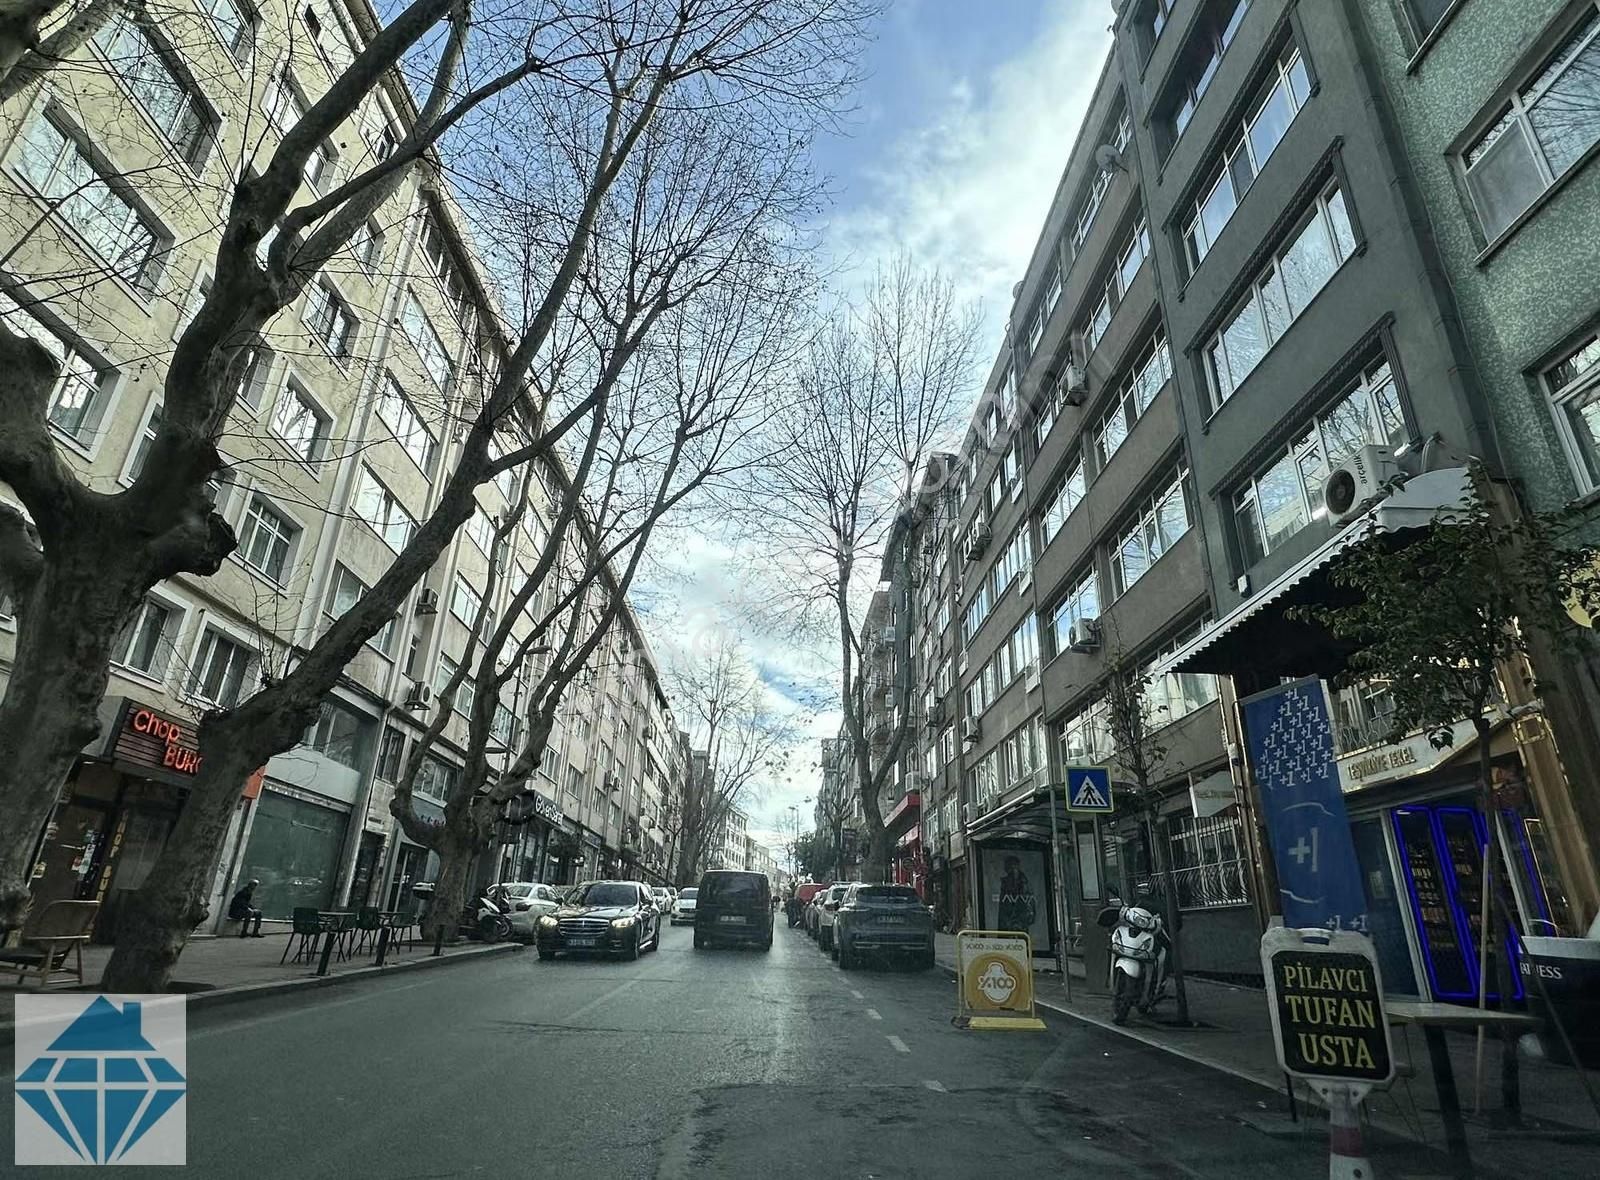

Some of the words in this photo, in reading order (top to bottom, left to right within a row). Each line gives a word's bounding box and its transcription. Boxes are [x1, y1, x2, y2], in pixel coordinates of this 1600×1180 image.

[1353, 454, 1368, 485] arçelik
[135, 710, 181, 746] Chop
[980, 976, 1015, 990] %100
[1283, 962, 1368, 993] PİLAVCI
[1285, 995, 1376, 1029] TUFAN
[1298, 1033, 1377, 1070] USTA
